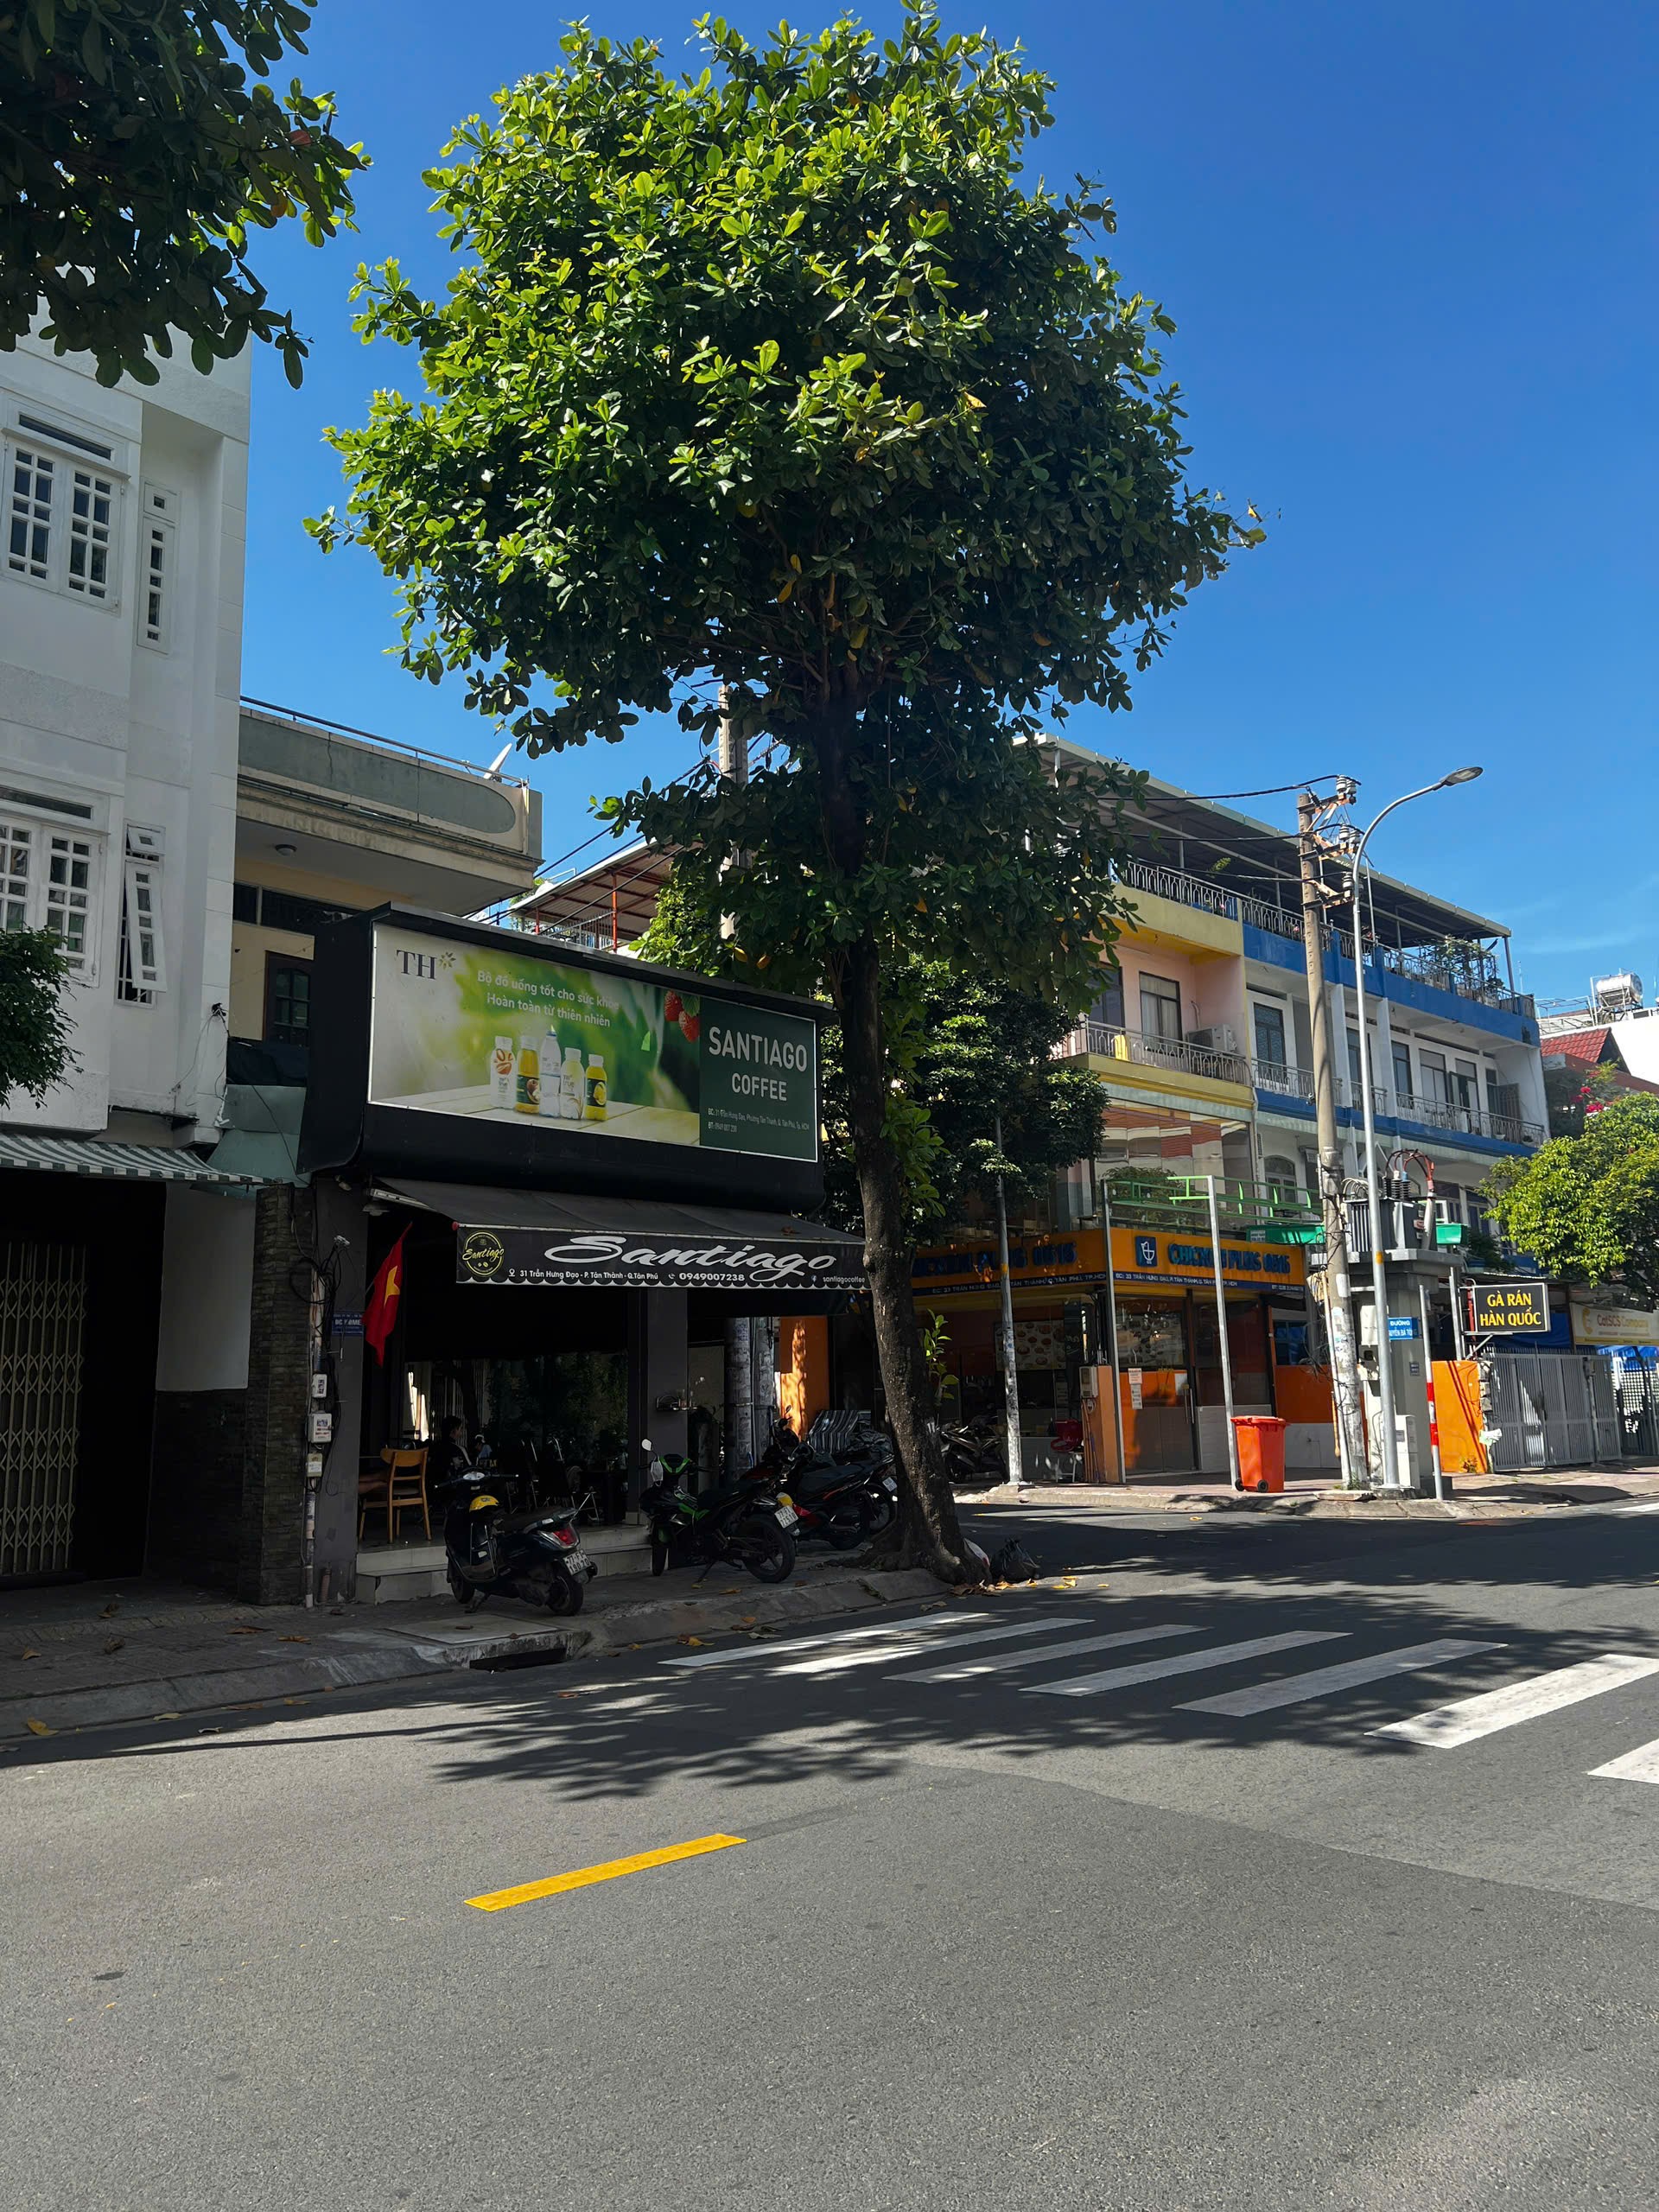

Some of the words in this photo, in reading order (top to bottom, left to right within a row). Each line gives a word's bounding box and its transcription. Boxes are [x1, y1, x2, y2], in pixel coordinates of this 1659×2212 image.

[396, 949, 437, 980] TH
[477, 969, 493, 987] Bộ
[512, 978, 538, 995] uống
[540, 982, 556, 997] tốt
[557, 986, 575, 1001] cho
[486, 992, 515, 1009] Hoàn
[518, 998, 541, 1014] toàn
[543, 1001, 556, 1016] từ
[557, 1007, 582, 1022] thiên
[584, 1012, 611, 1027] nhiên
[709, 1026, 807, 1072] SANTIAGO
[731, 1072, 787, 1102] COFFEE
[462, 1247, 505, 1262] Santiago
[544, 1236, 837, 1282] Santiago
[546, 1270, 564, 1280] Hưng
[566, 1270, 579, 1279] Đạo
[604, 1270, 623, 1279] Thành
[678, 1272, 745, 1281] 0949007238
[1486, 1290, 1504, 1307] GÀ
[1507, 1288, 1532, 1306] RÁN
[1479, 1308, 1505, 1326] HÀN
[1507, 1306, 1542, 1327] QUỐC
